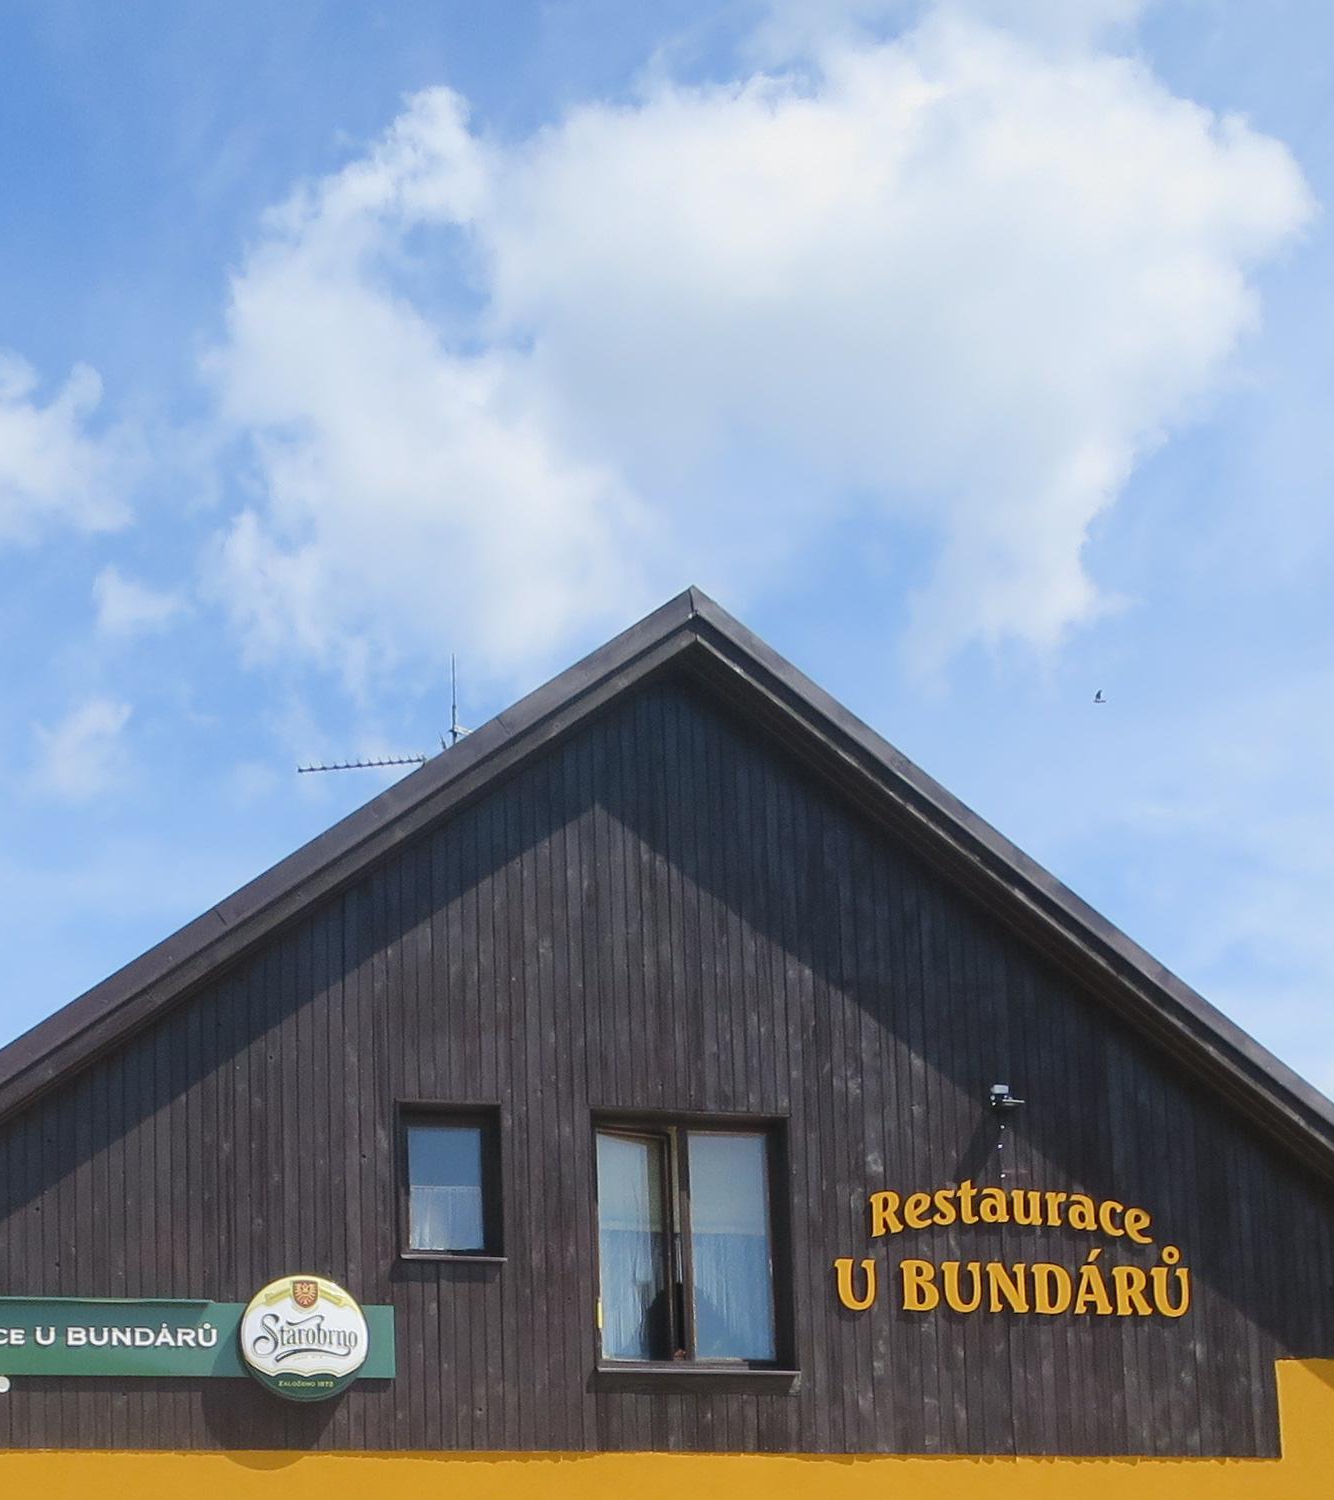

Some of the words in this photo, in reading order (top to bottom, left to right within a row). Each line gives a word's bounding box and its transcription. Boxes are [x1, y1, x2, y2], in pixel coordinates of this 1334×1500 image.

[870, 1179, 1153, 1244] Restaurace
[834, 1258, 876, 1311] U
[899, 1245, 1190, 1318] BUNDÁRŮ
[35, 1326, 55, 1345] U
[68, 1323, 217, 1348] BUNDÁRŮ
[253, 1313, 358, 1360] Starobrno
